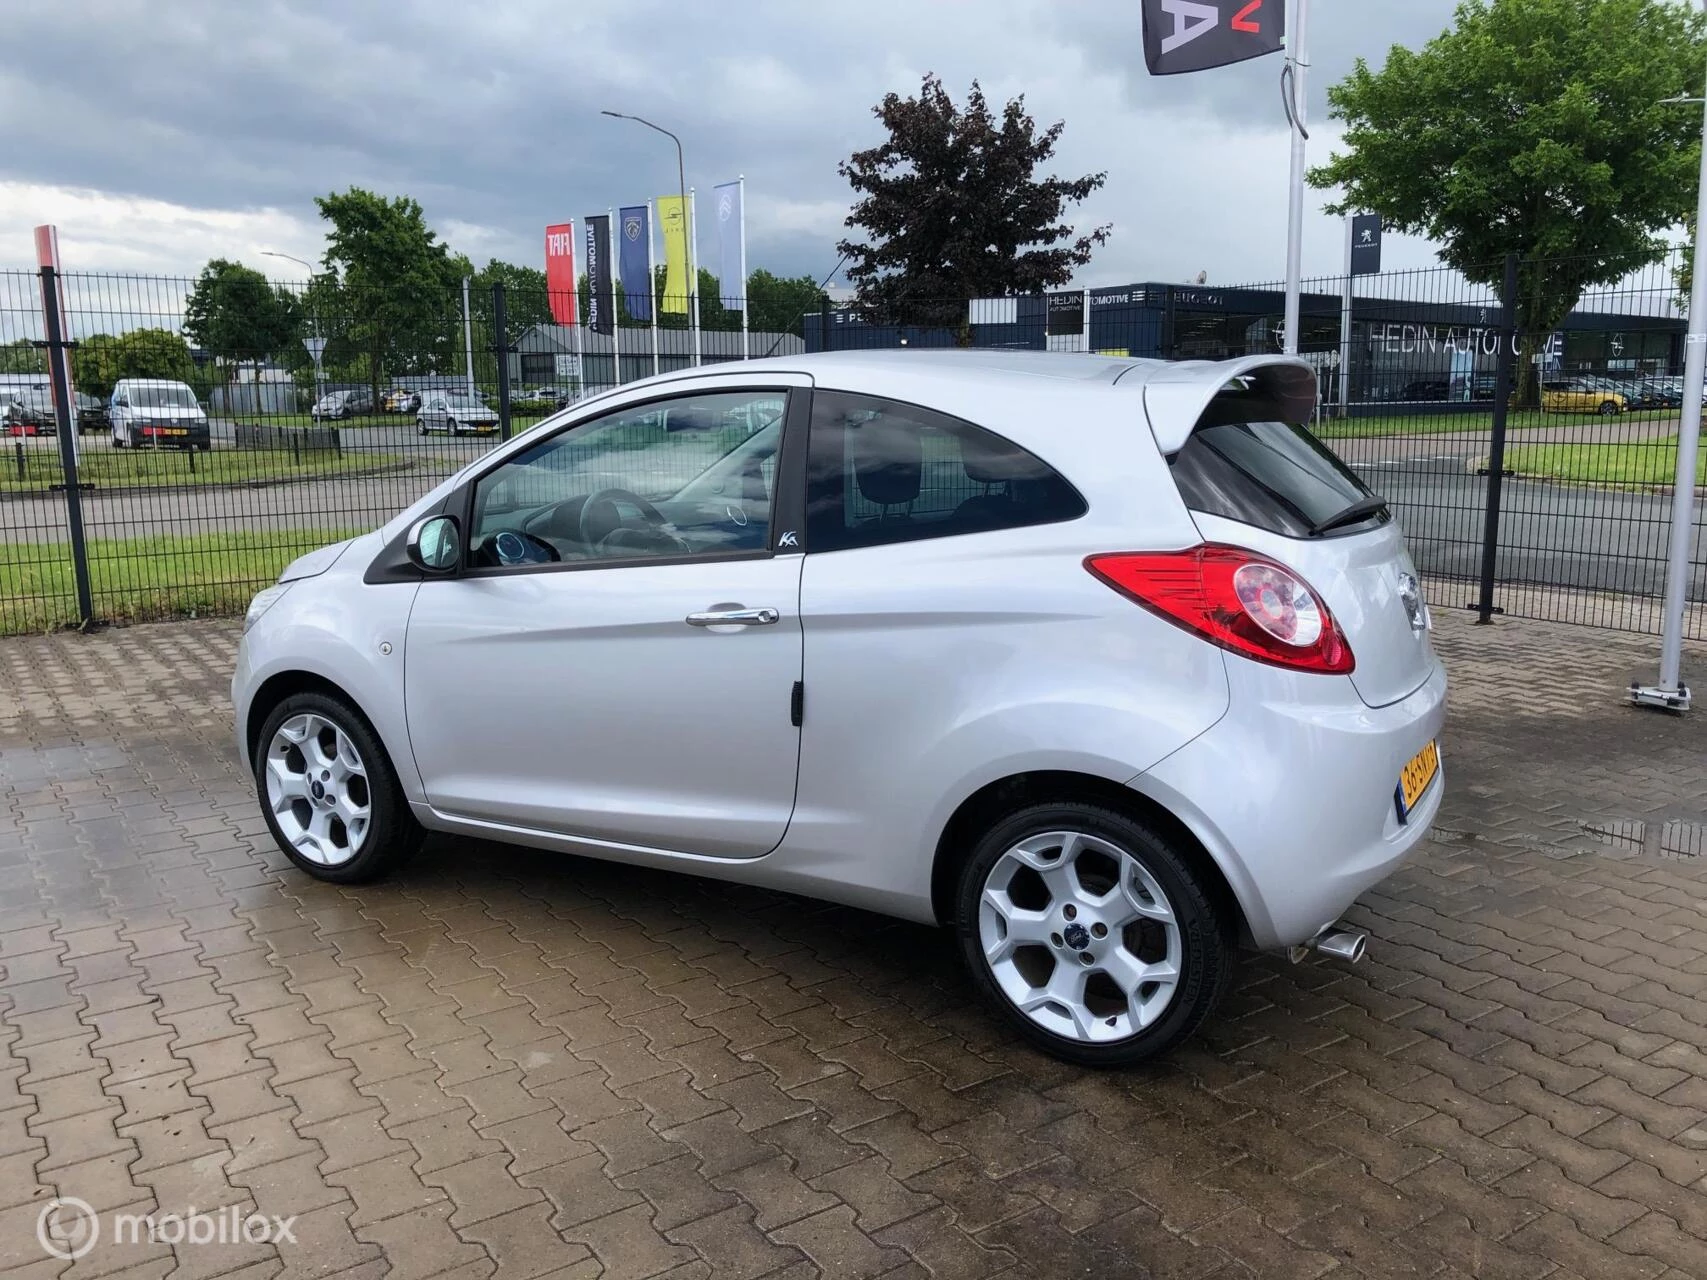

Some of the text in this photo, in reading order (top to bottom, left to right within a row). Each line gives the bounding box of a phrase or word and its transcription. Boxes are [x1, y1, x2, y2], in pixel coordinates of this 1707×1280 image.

[1049, 295, 1083, 306] HEDIN
[1165, 292, 1224, 305] EUGEOT
[1368, 324, 1437, 353] HEDIN
